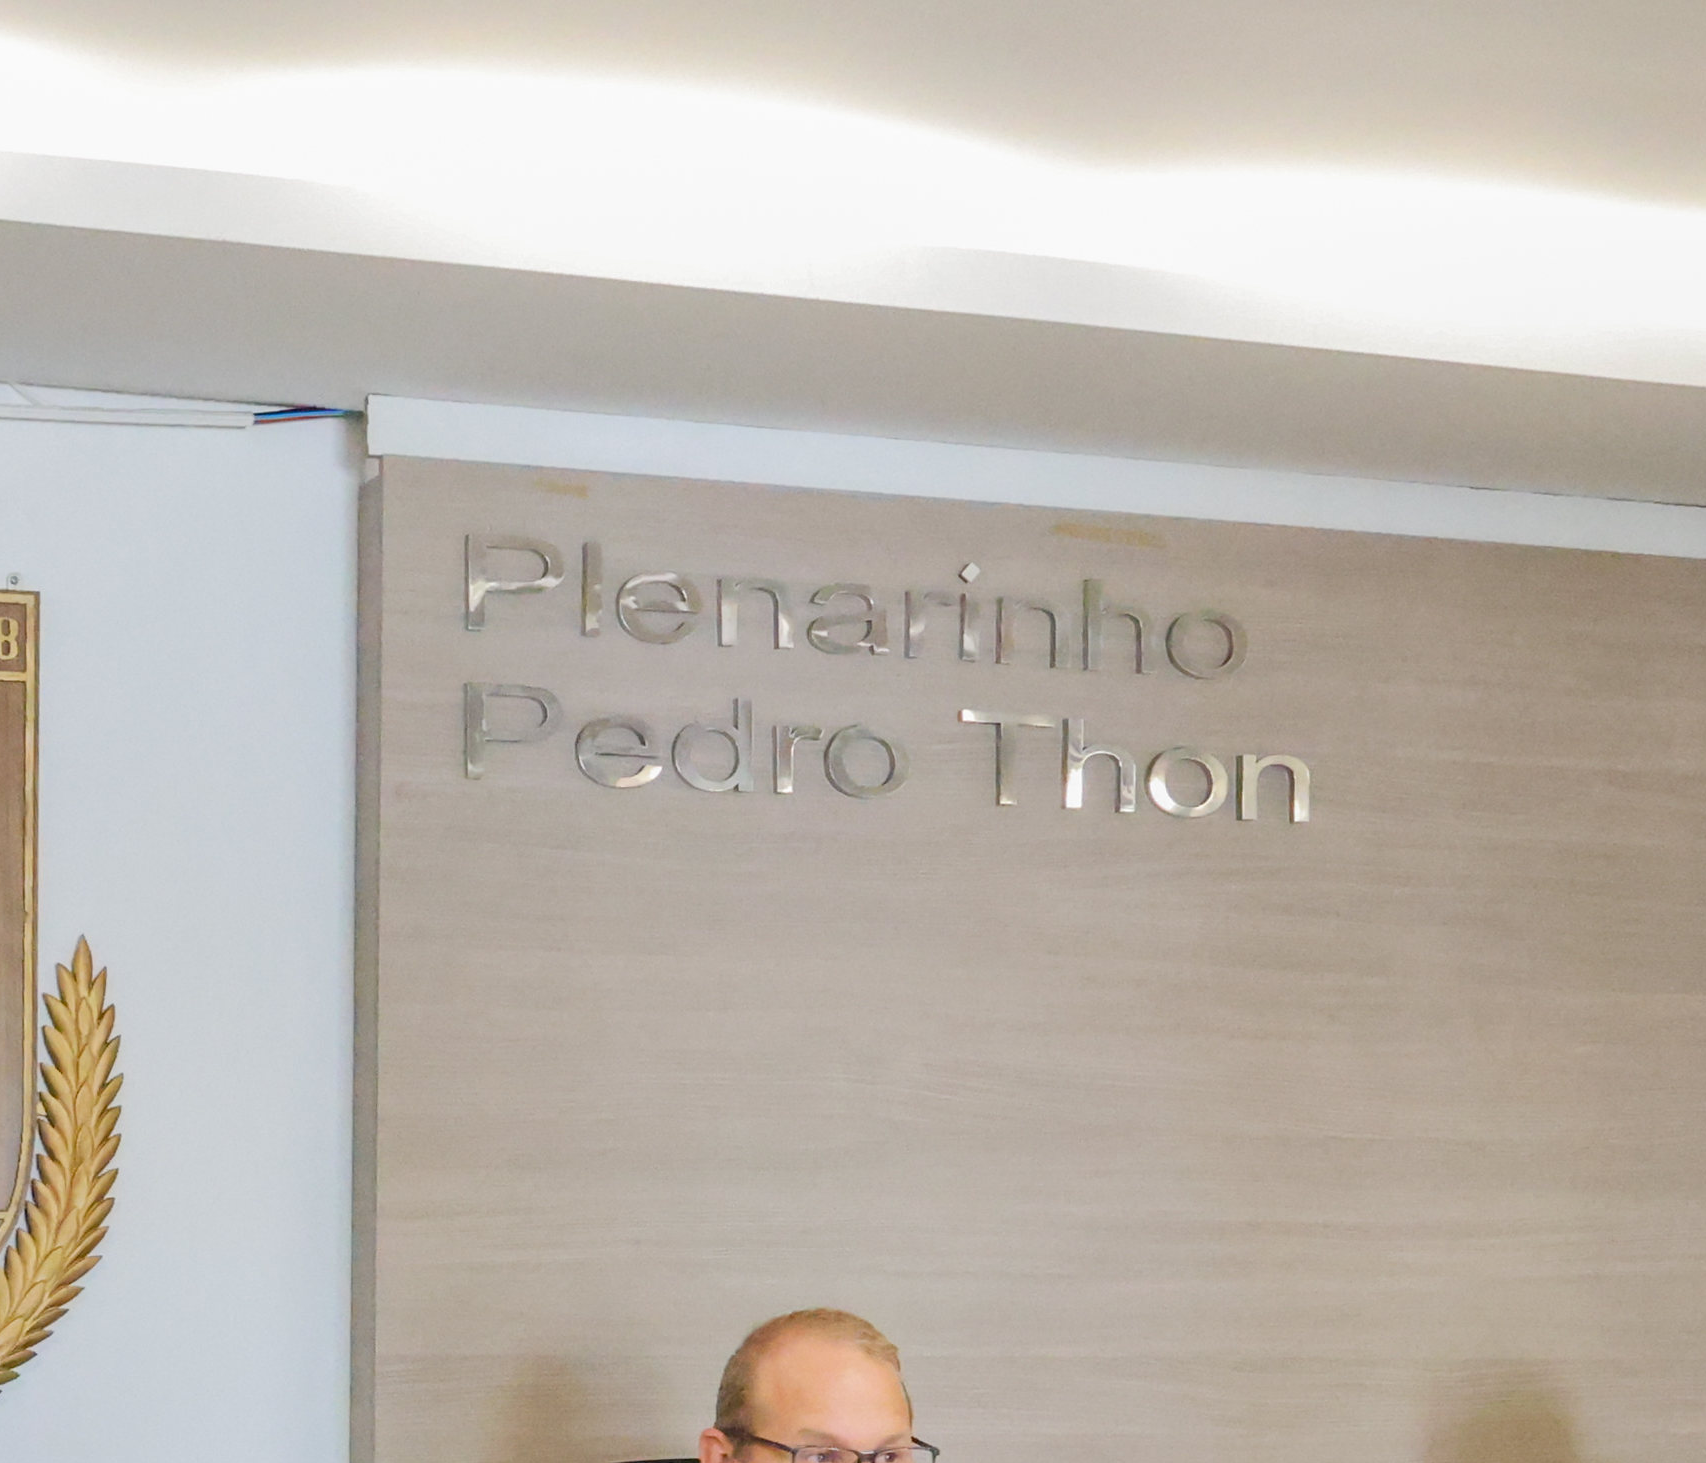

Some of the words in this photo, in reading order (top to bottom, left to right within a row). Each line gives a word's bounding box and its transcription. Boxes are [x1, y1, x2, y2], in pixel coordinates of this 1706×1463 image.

[464, 532, 1250, 680] Plenarinho
[464, 681, 910, 799] Pedro
[958, 706, 1312, 824] Thon
